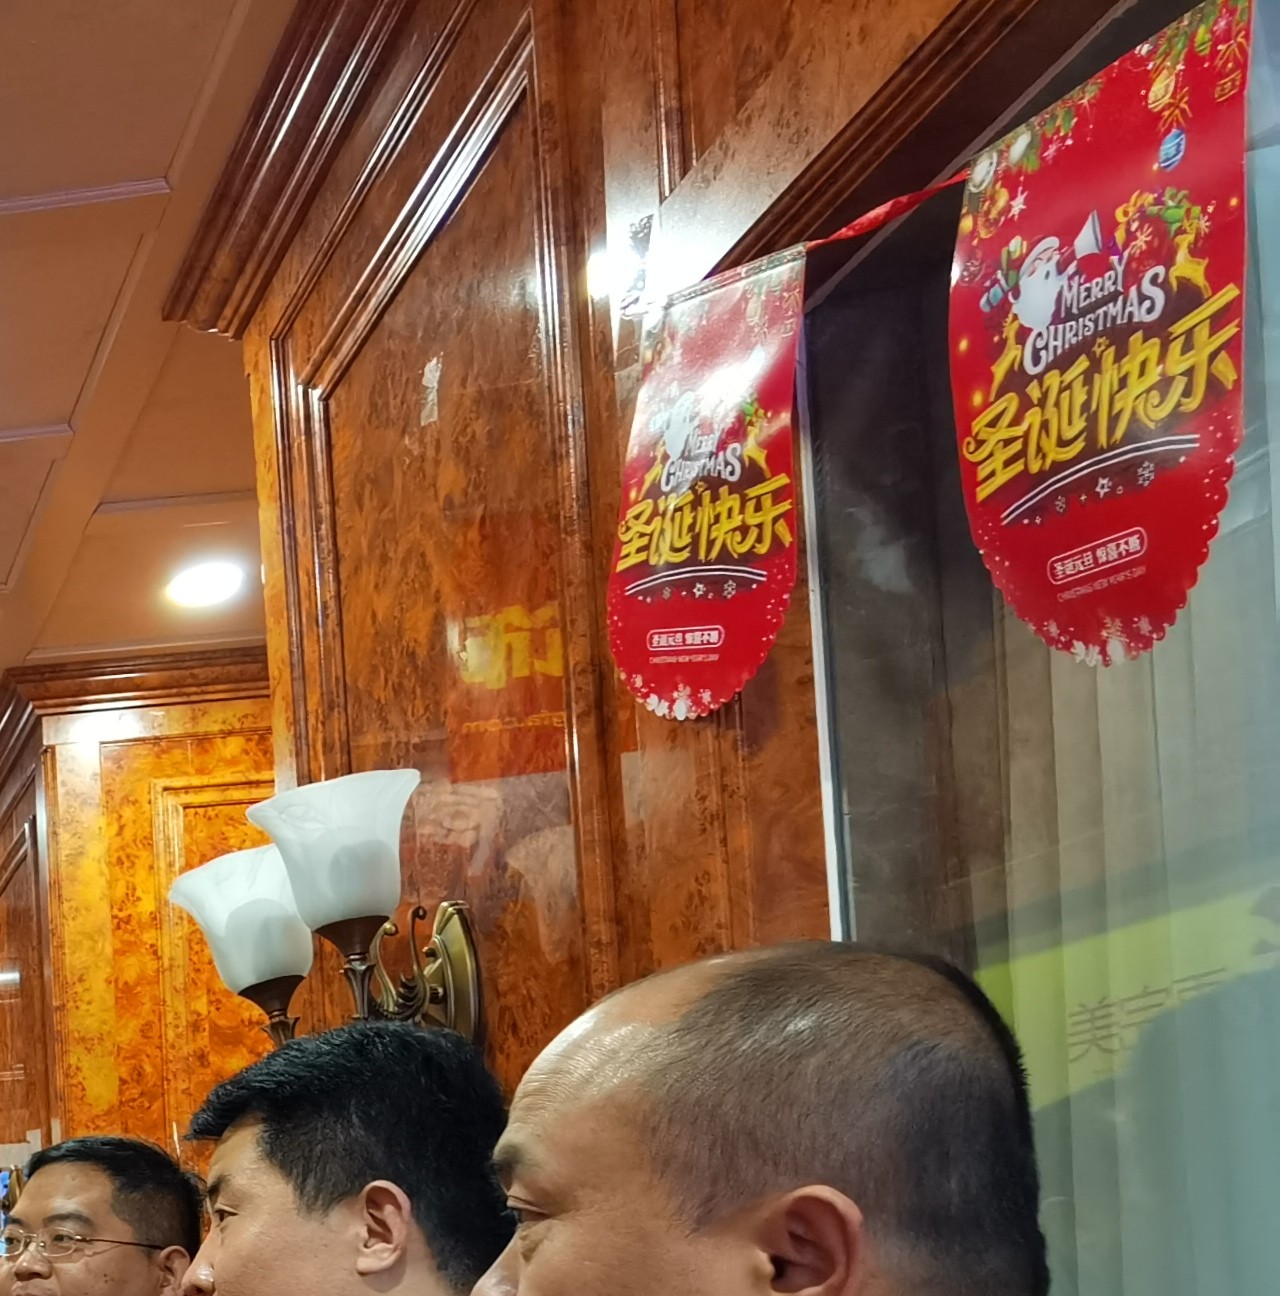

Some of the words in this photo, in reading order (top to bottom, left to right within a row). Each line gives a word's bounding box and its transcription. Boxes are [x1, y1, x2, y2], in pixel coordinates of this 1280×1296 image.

[1023, 265, 1166, 375] CHRISTMAS
[1061, 254, 1128, 316] MERRY
[962, 283, 1240, 503] 圣诞快乐
[616, 473, 793, 573] 圣诞快乐
